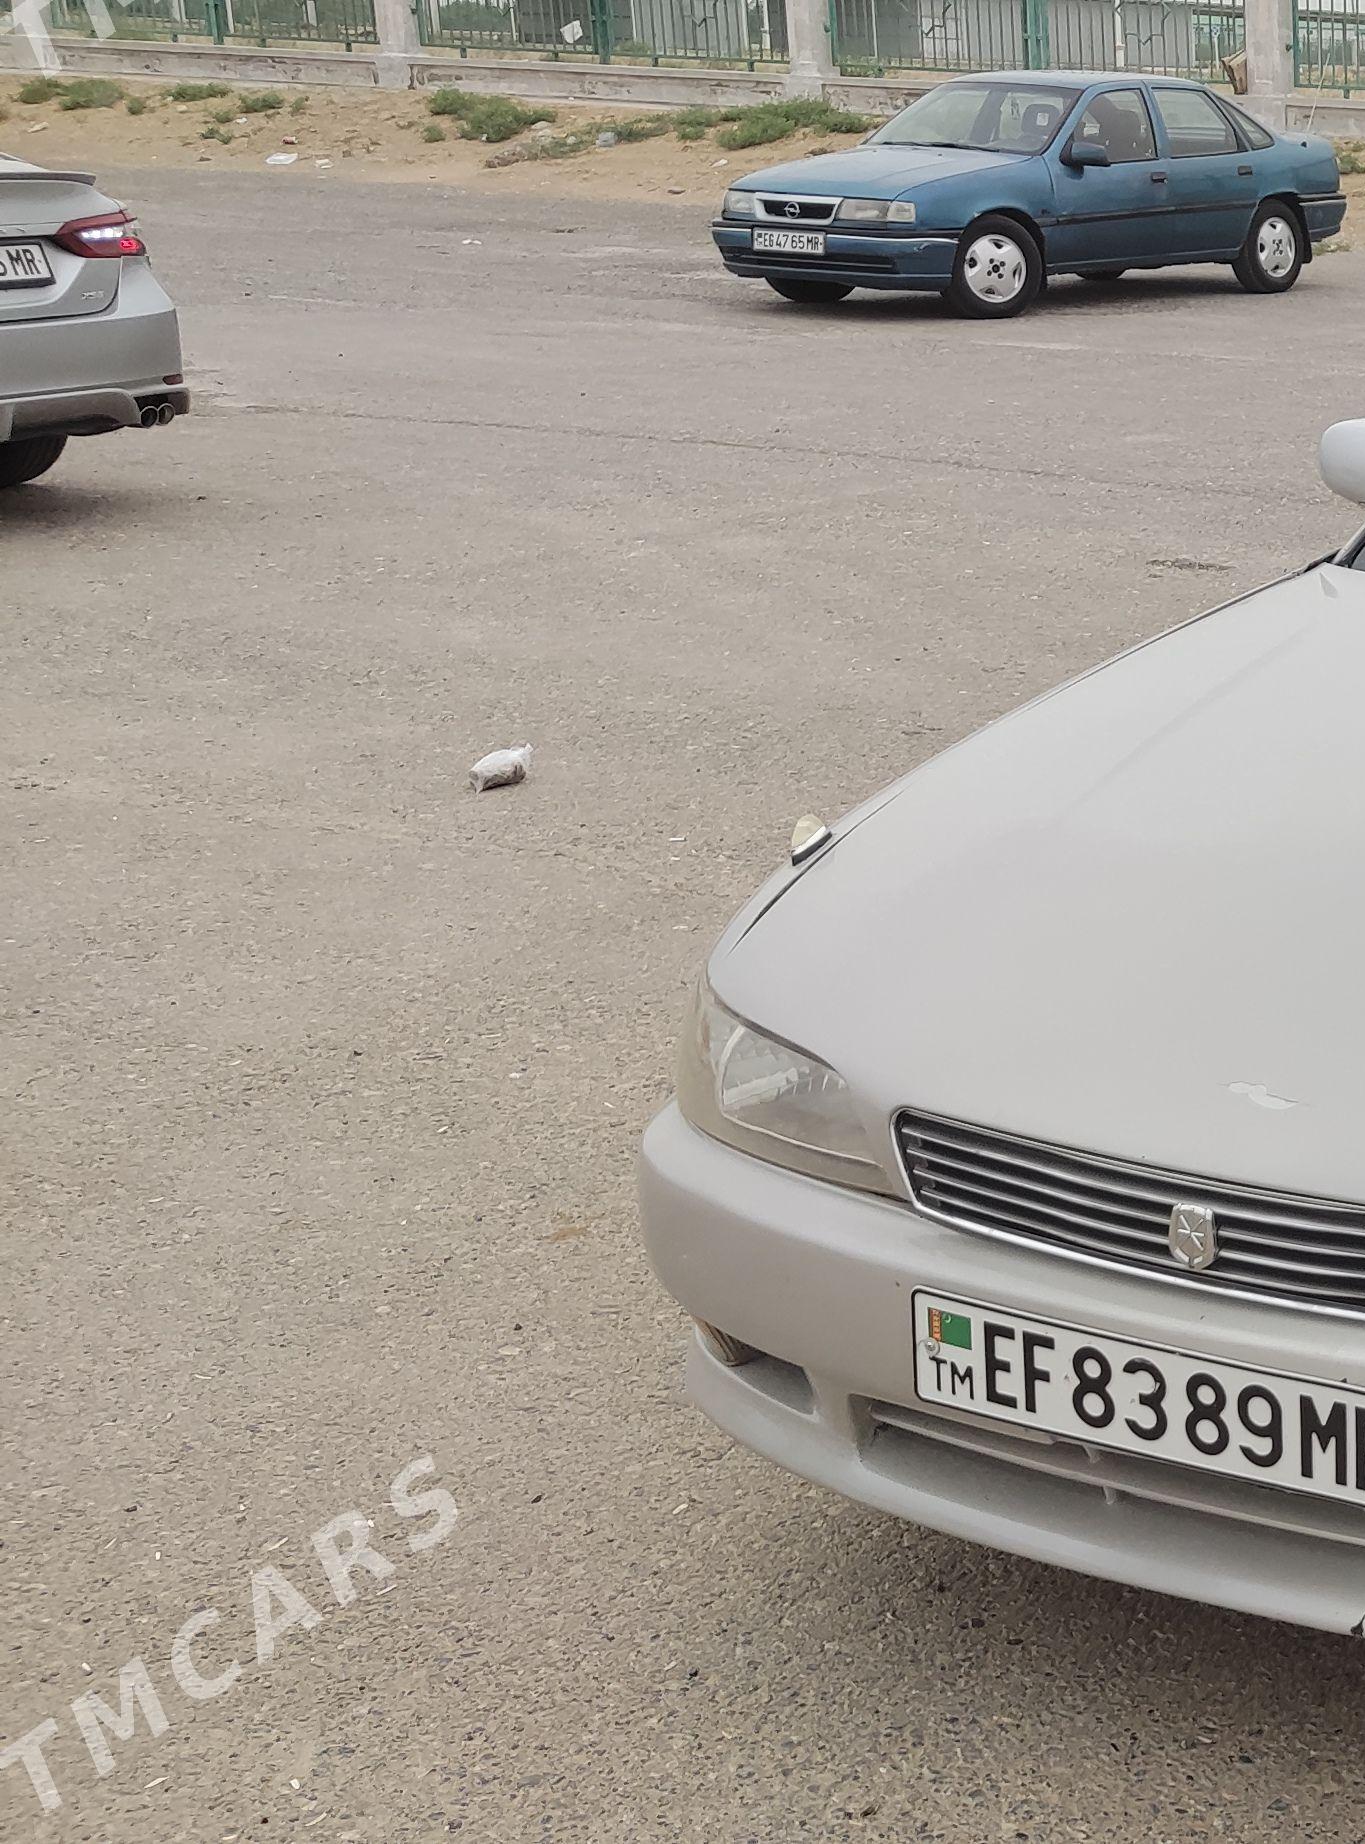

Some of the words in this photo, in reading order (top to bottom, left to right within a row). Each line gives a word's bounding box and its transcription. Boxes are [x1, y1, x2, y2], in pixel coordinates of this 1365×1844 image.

[763, 233, 774, 247] EG
[776, 234, 789, 248] 47
[791, 235, 804, 249] 65
[807, 235, 820, 250] MR
[6, 248, 41, 276] MR
[930, 1356, 975, 1400] TM
[983, 1320, 1055, 1414] EF
[1071, 1345, 1169, 1442] 83
[1184, 1371, 1284, 1468] 89
